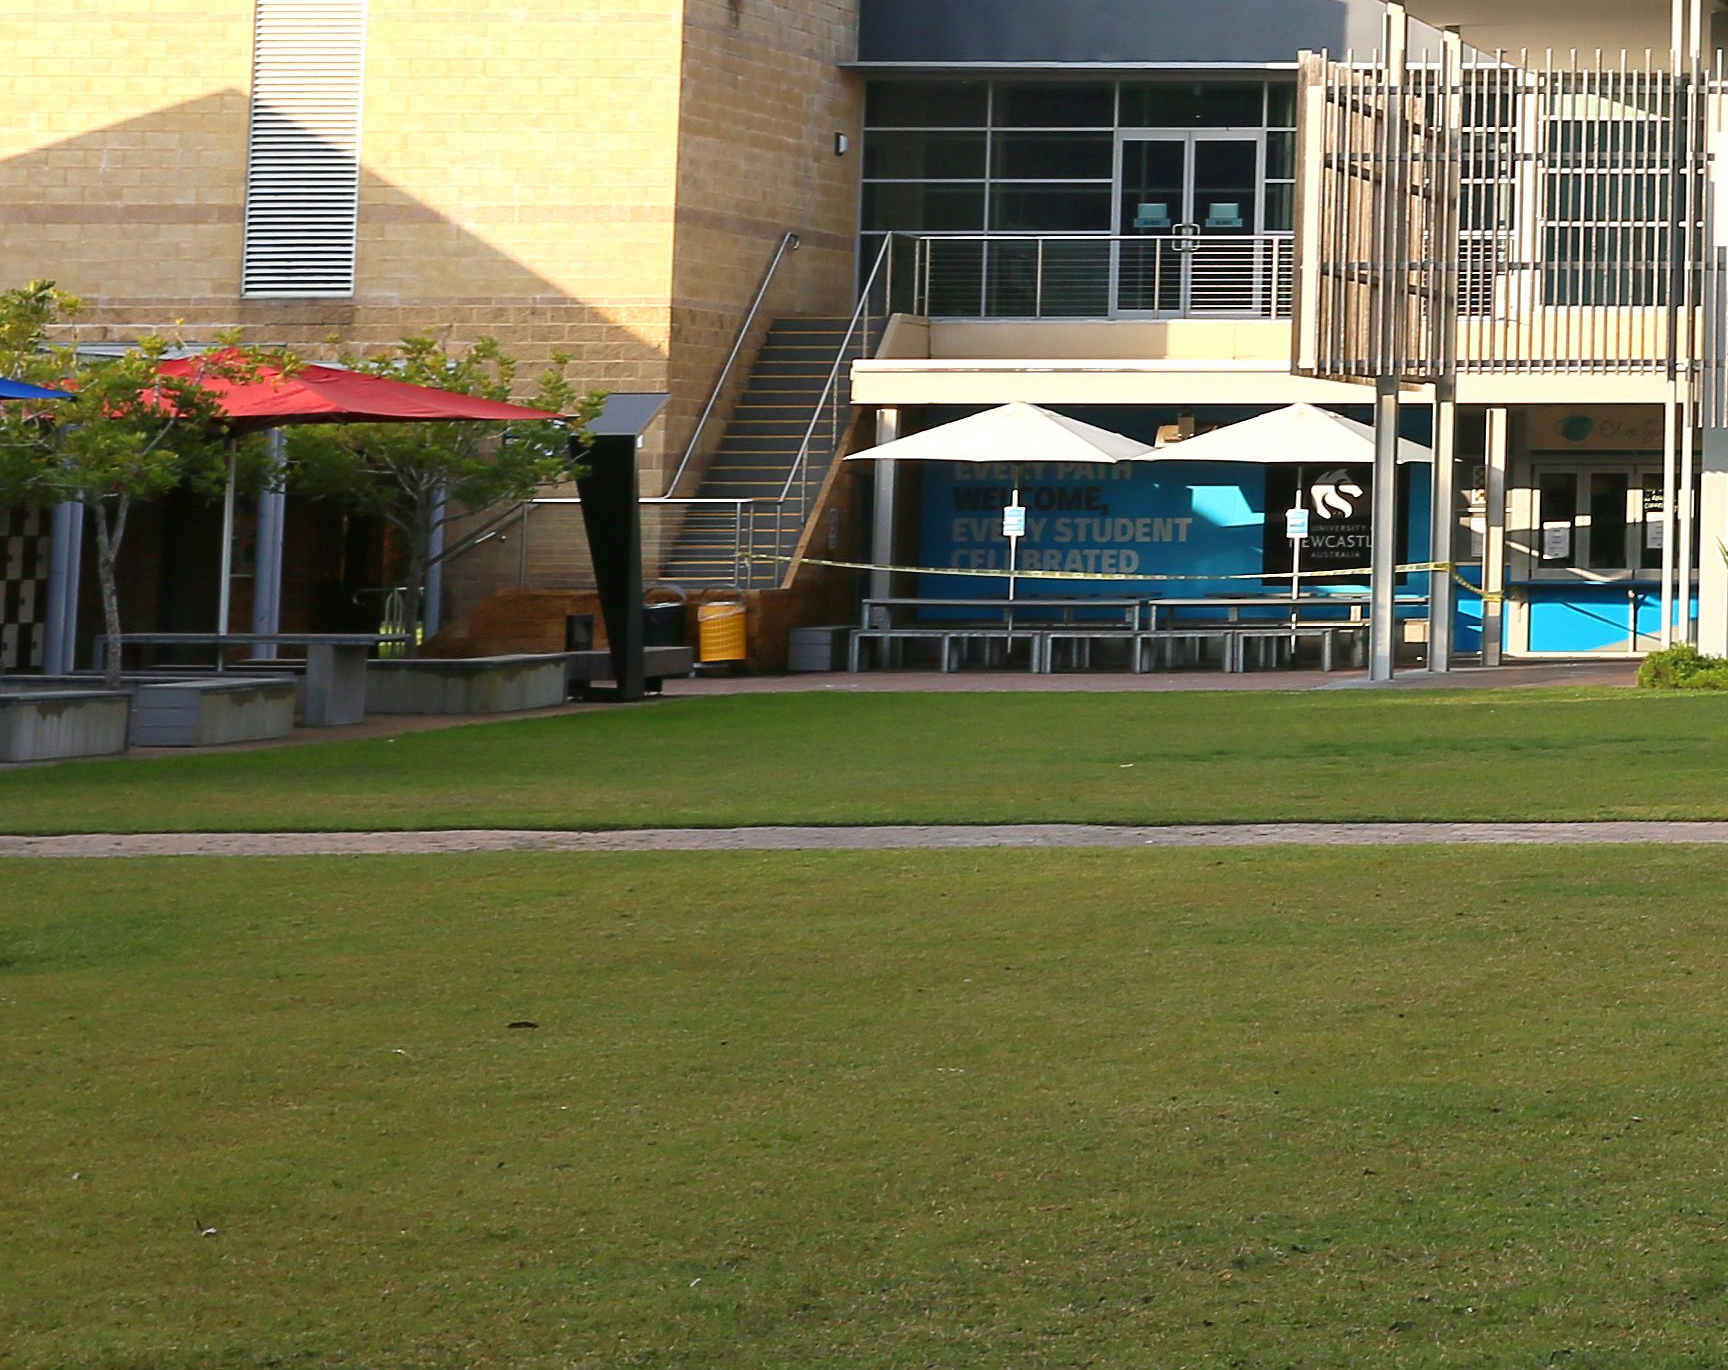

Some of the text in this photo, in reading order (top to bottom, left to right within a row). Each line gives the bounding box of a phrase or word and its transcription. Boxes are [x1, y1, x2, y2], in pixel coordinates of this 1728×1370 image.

[1056, 461, 1133, 480] PATH
[952, 517, 1192, 542] EVEY STUDENT
[1289, 535, 1372, 548] EWCASTL
